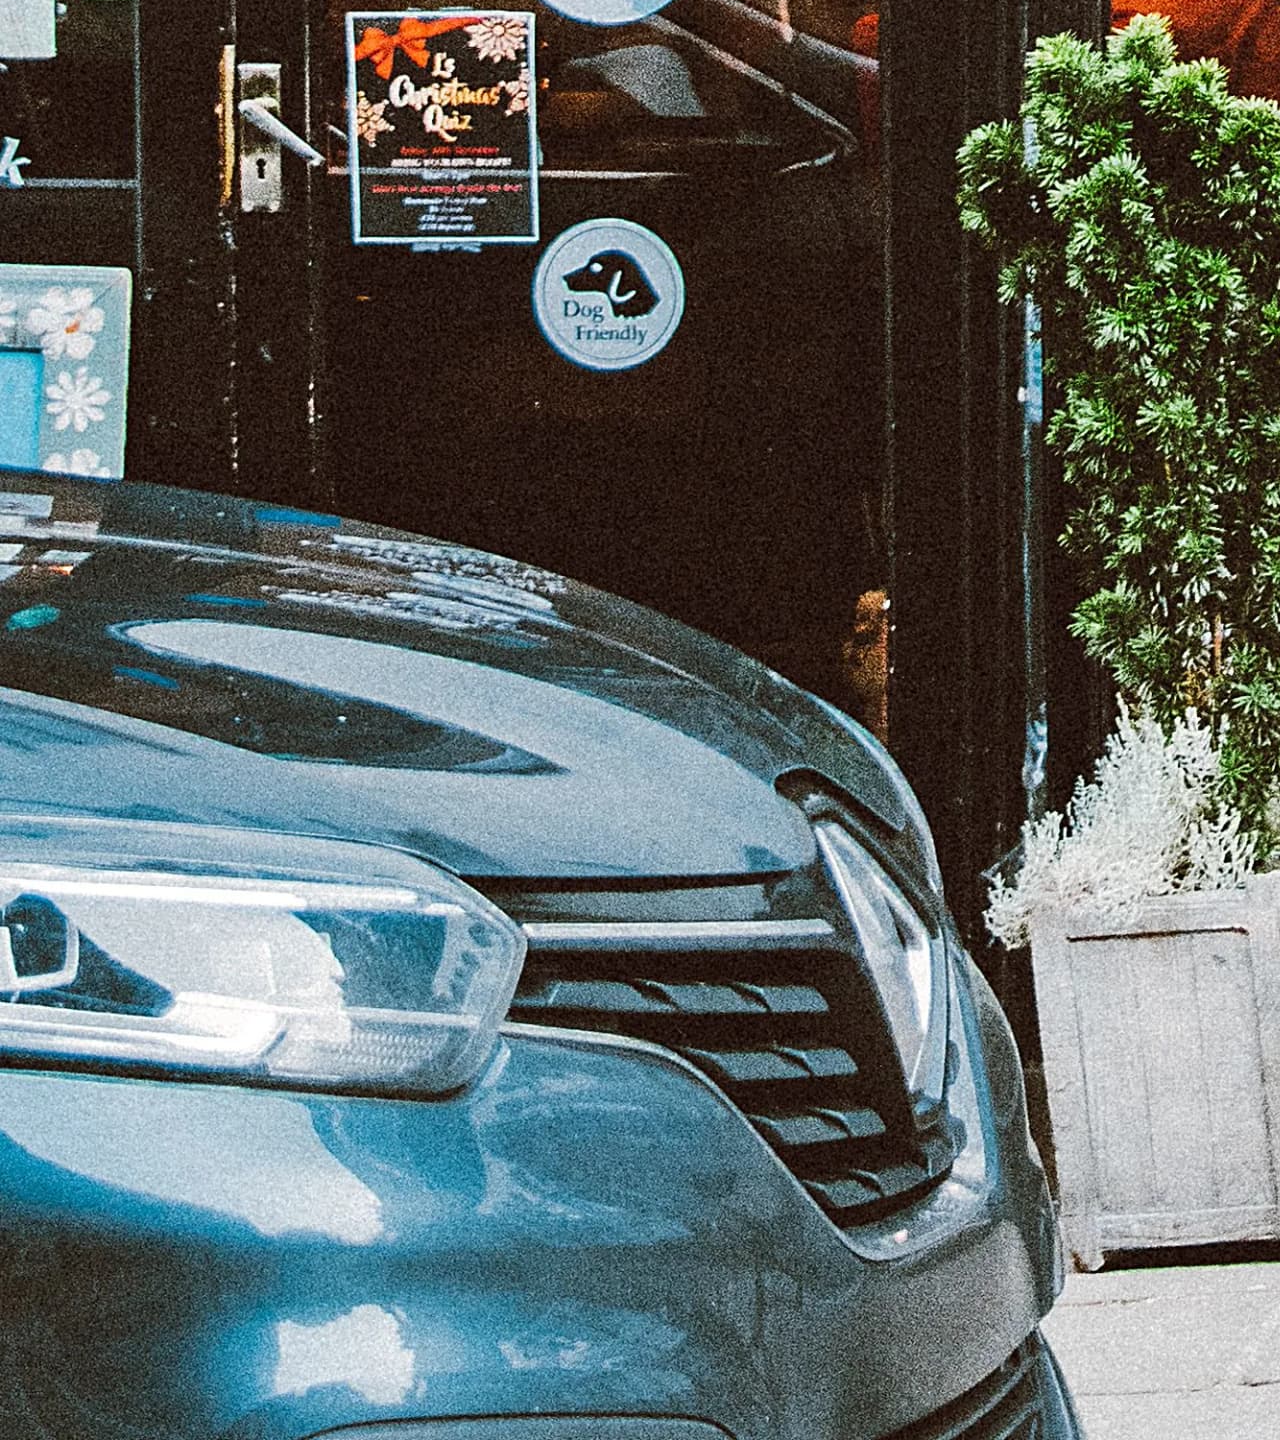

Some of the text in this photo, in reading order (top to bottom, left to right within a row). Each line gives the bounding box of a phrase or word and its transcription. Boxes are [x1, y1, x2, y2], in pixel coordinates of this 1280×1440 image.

[389, 75, 500, 111] Christmas
[423, 104, 473, 142] Quiz
[563, 300, 605, 323] Dog
[575, 325, 648, 345] Friendly
